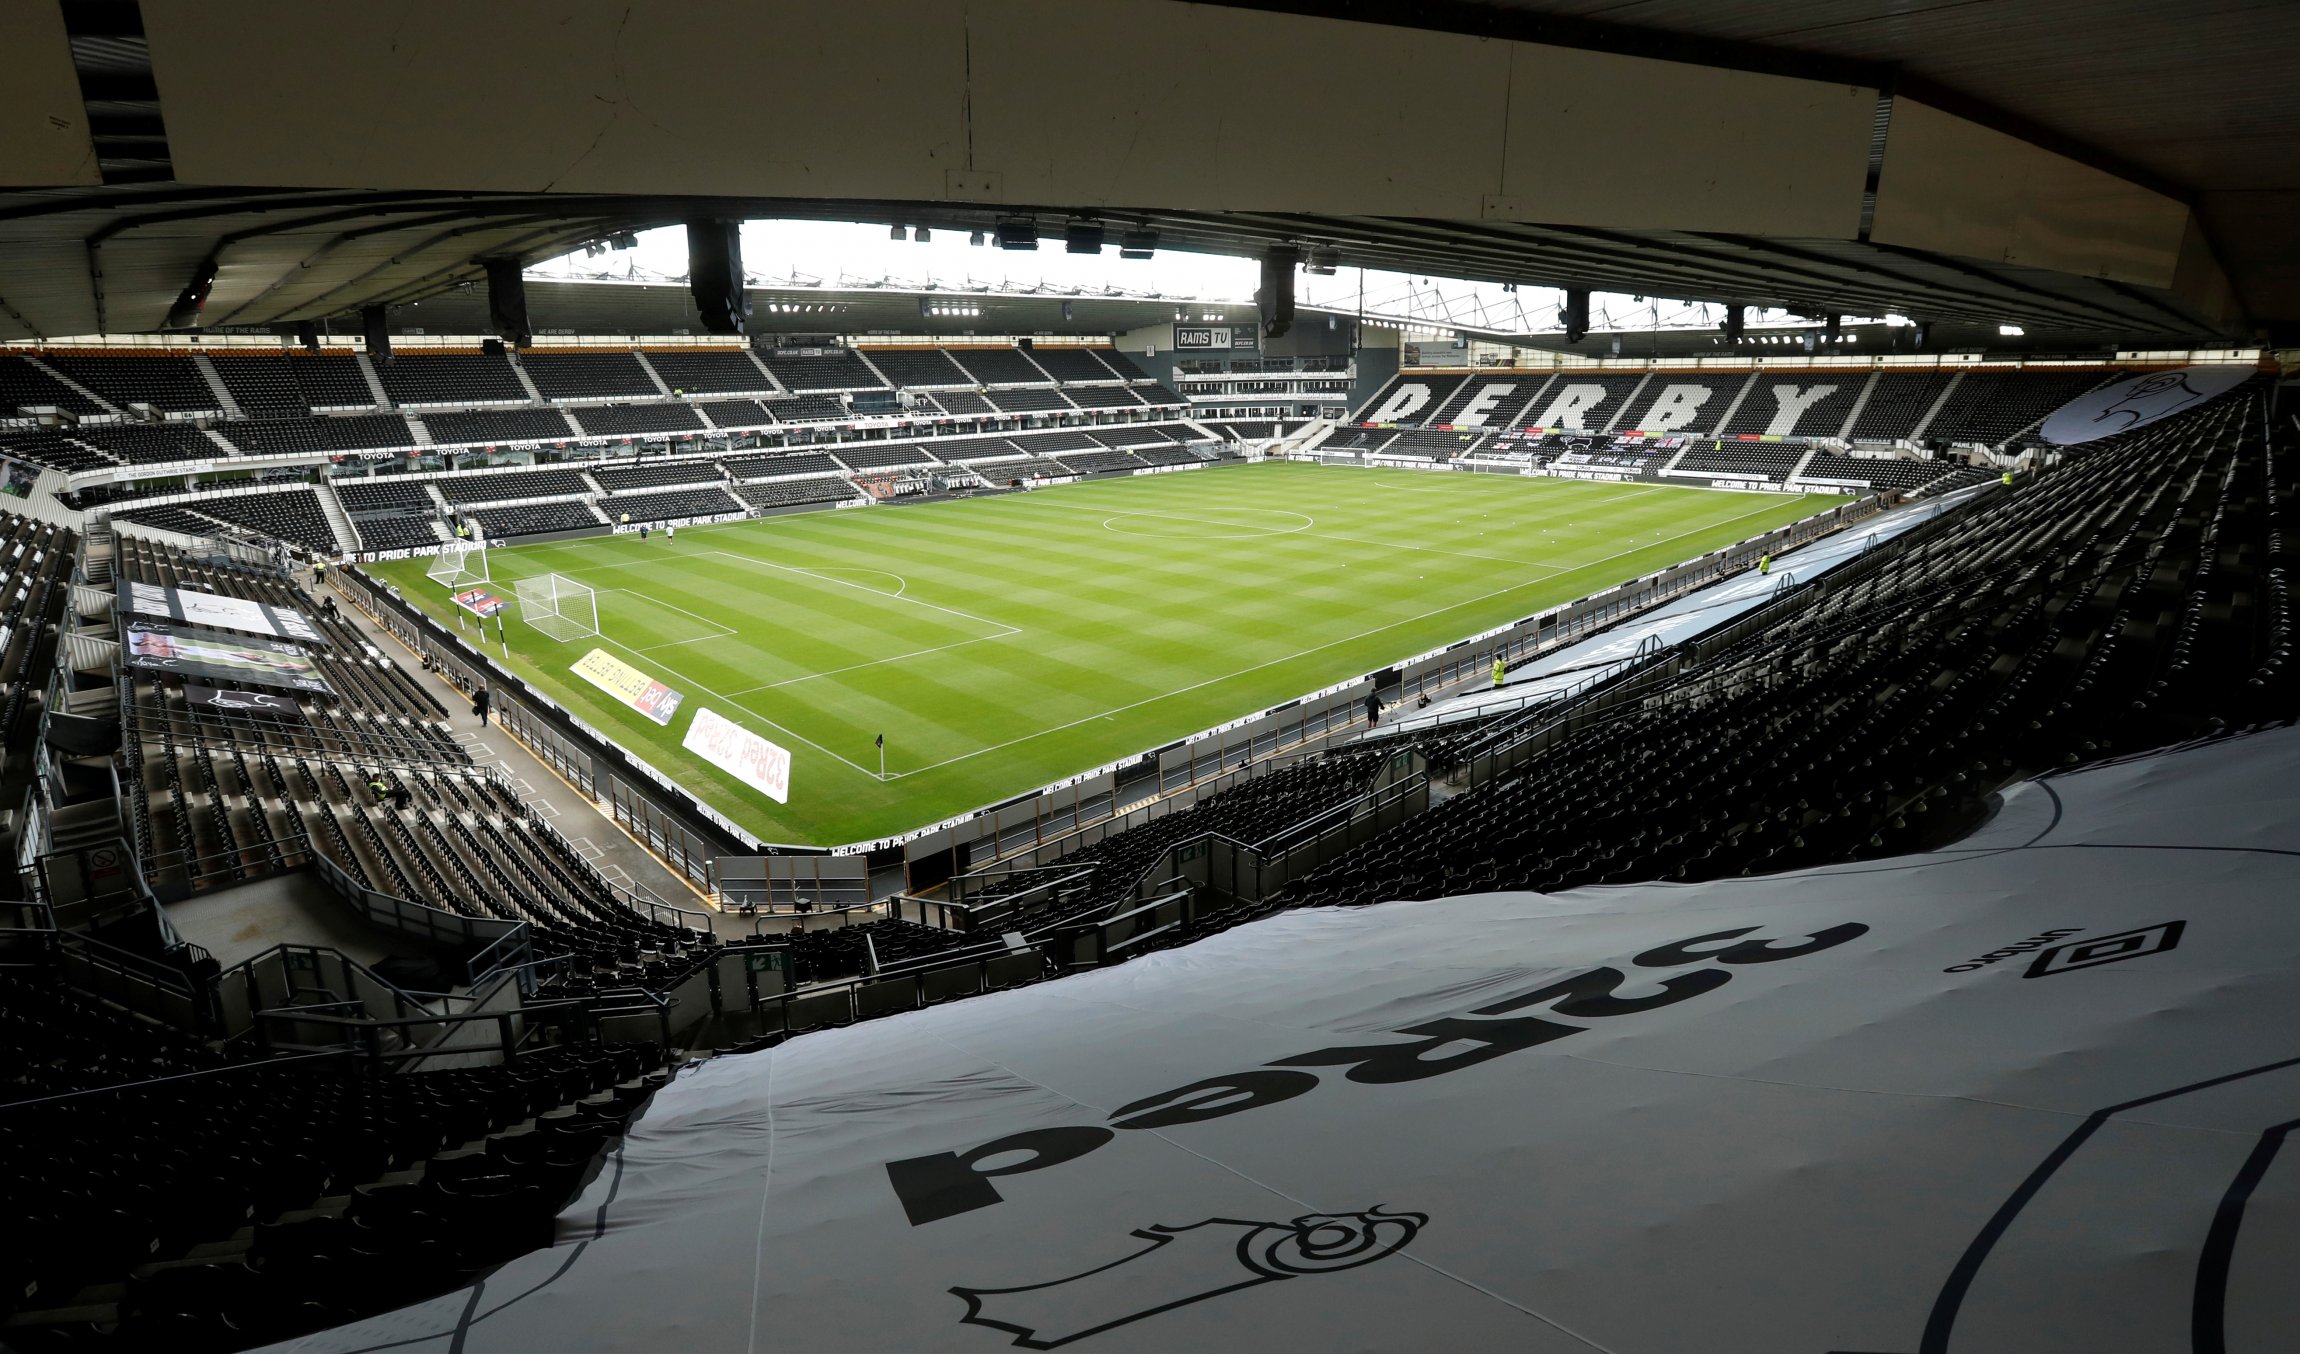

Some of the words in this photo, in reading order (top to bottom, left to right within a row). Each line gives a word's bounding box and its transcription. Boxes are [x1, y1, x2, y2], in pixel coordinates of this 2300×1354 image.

[1180, 331, 1210, 344] RAMS
[1214, 331, 1228, 344] TV
[1366, 383, 1839, 435] DERBY
[435, 447, 470, 455] TOYOTA
[509, 443, 541, 451] TOYOTA
[579, 439, 608, 447] TOYOTA
[358, 452, 395, 460] TOYOTA
[1550, 469, 1557, 477] TO
[1557, 470, 1577, 478] PRIDE
[1577, 471, 1593, 480] PARK
[1593, 472, 1622, 481] STADIUM
[1711, 479, 1747, 489] WELCOME
[1748, 482, 1758, 490] TO
[1759, 482, 1782, 492] PRIDE
[1783, 483, 1804, 493] PARK
[1805, 485, 1840, 495] STADIUM
[835, 499, 866, 509] WELCOME
[866, 497, 877, 505] TO
[655, 520, 665, 529] TO
[692, 516, 712, 525] PARK
[714, 511, 747, 523] STADIUM
[363, 552, 376, 563] TO
[378, 548, 411, 561] PRIDE
[413, 544, 441, 557] PARK
[442, 540, 487, 554] STADIUM
[608, 668, 646, 697] BETTING
[640, 686, 662, 711] bet
[656, 692, 678, 718] sky
[739, 736, 786, 790] 32Red
[1042, 780, 1074, 796] WELCOME
[1074, 777, 1082, 785] TO
[1083, 770, 1102, 783] PRIDE
[1102, 763, 1118, 775] PARK
[1118, 754, 1143, 770] STADIUM
[831, 841, 876, 857] WELCOME
[878, 838, 890, 850] TO
[892, 833, 919, 848] PRIDE
[920, 824, 941, 838] PARK
[942, 813, 974, 830] STADIUM
[1942, 927, 2087, 974] umbro
[885, 921, 1871, 1227] 32Red
